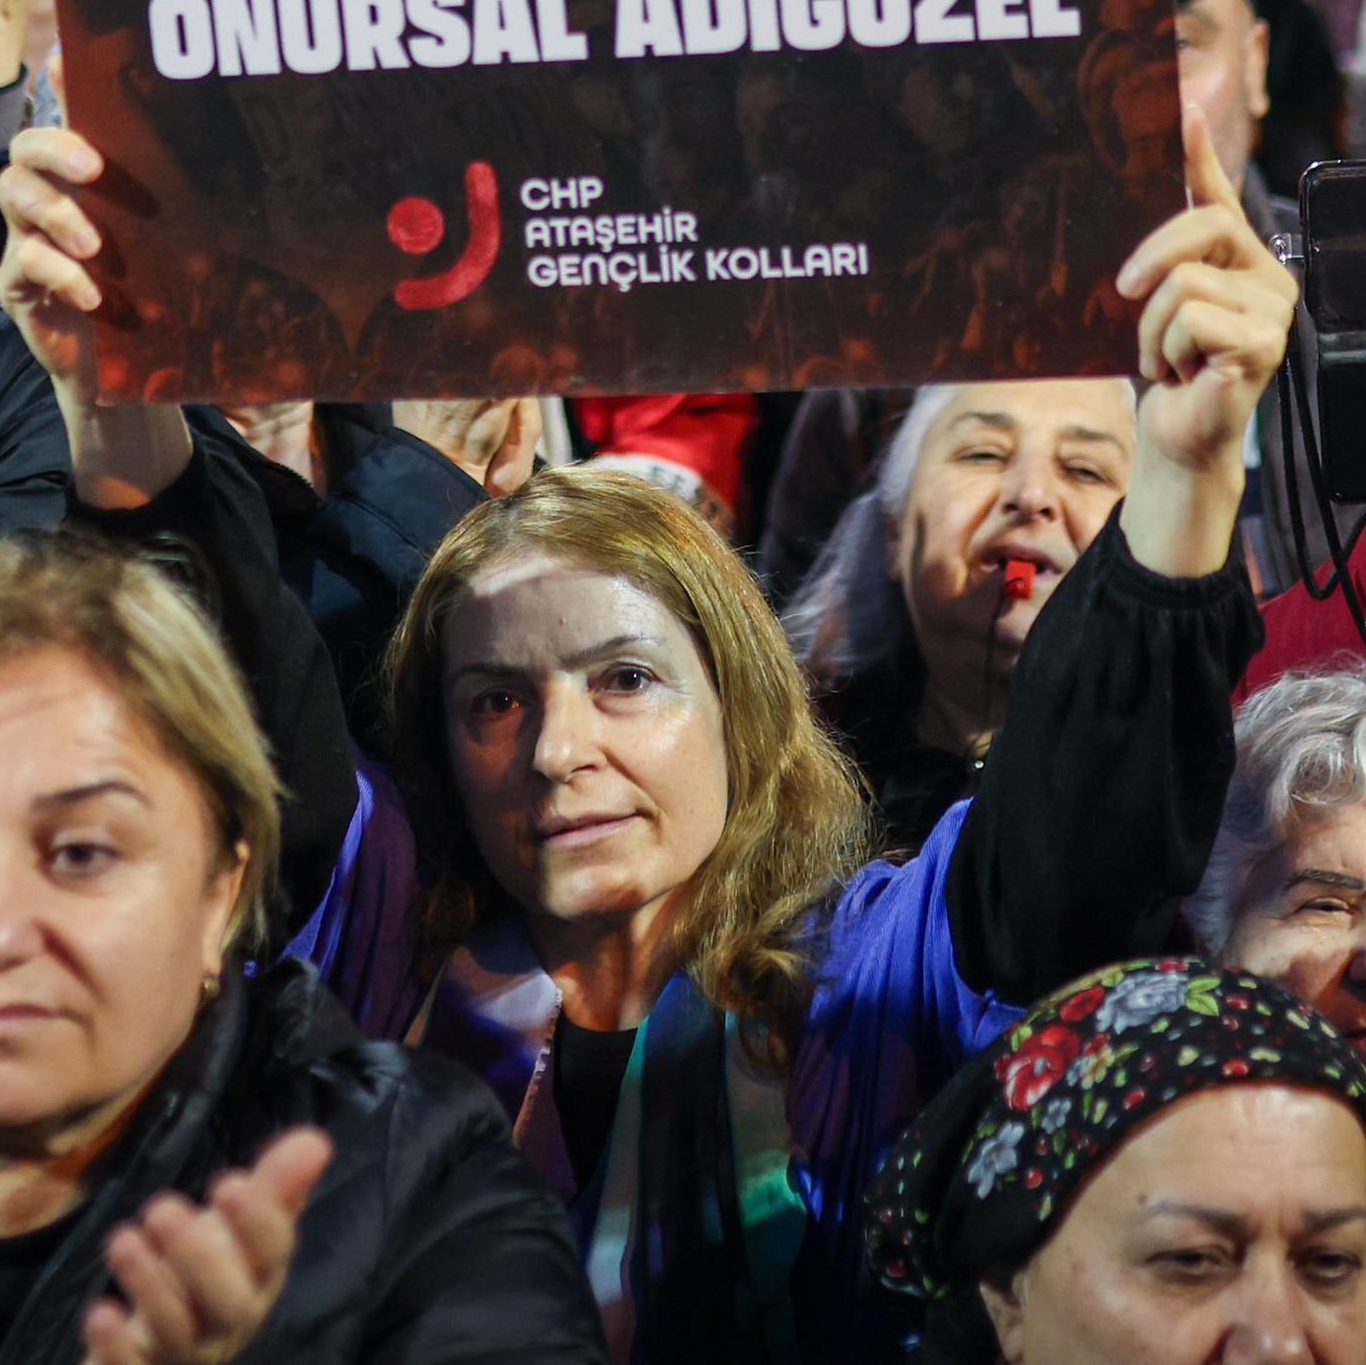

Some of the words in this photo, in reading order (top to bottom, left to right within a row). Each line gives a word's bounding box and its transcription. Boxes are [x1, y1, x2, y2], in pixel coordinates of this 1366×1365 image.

[520, 176, 604, 211] CHP
[525, 205, 698, 253] ATAŞEHİR
[528, 244, 696, 292] GENÇLİK
[705, 242, 869, 281] KOLLARI
